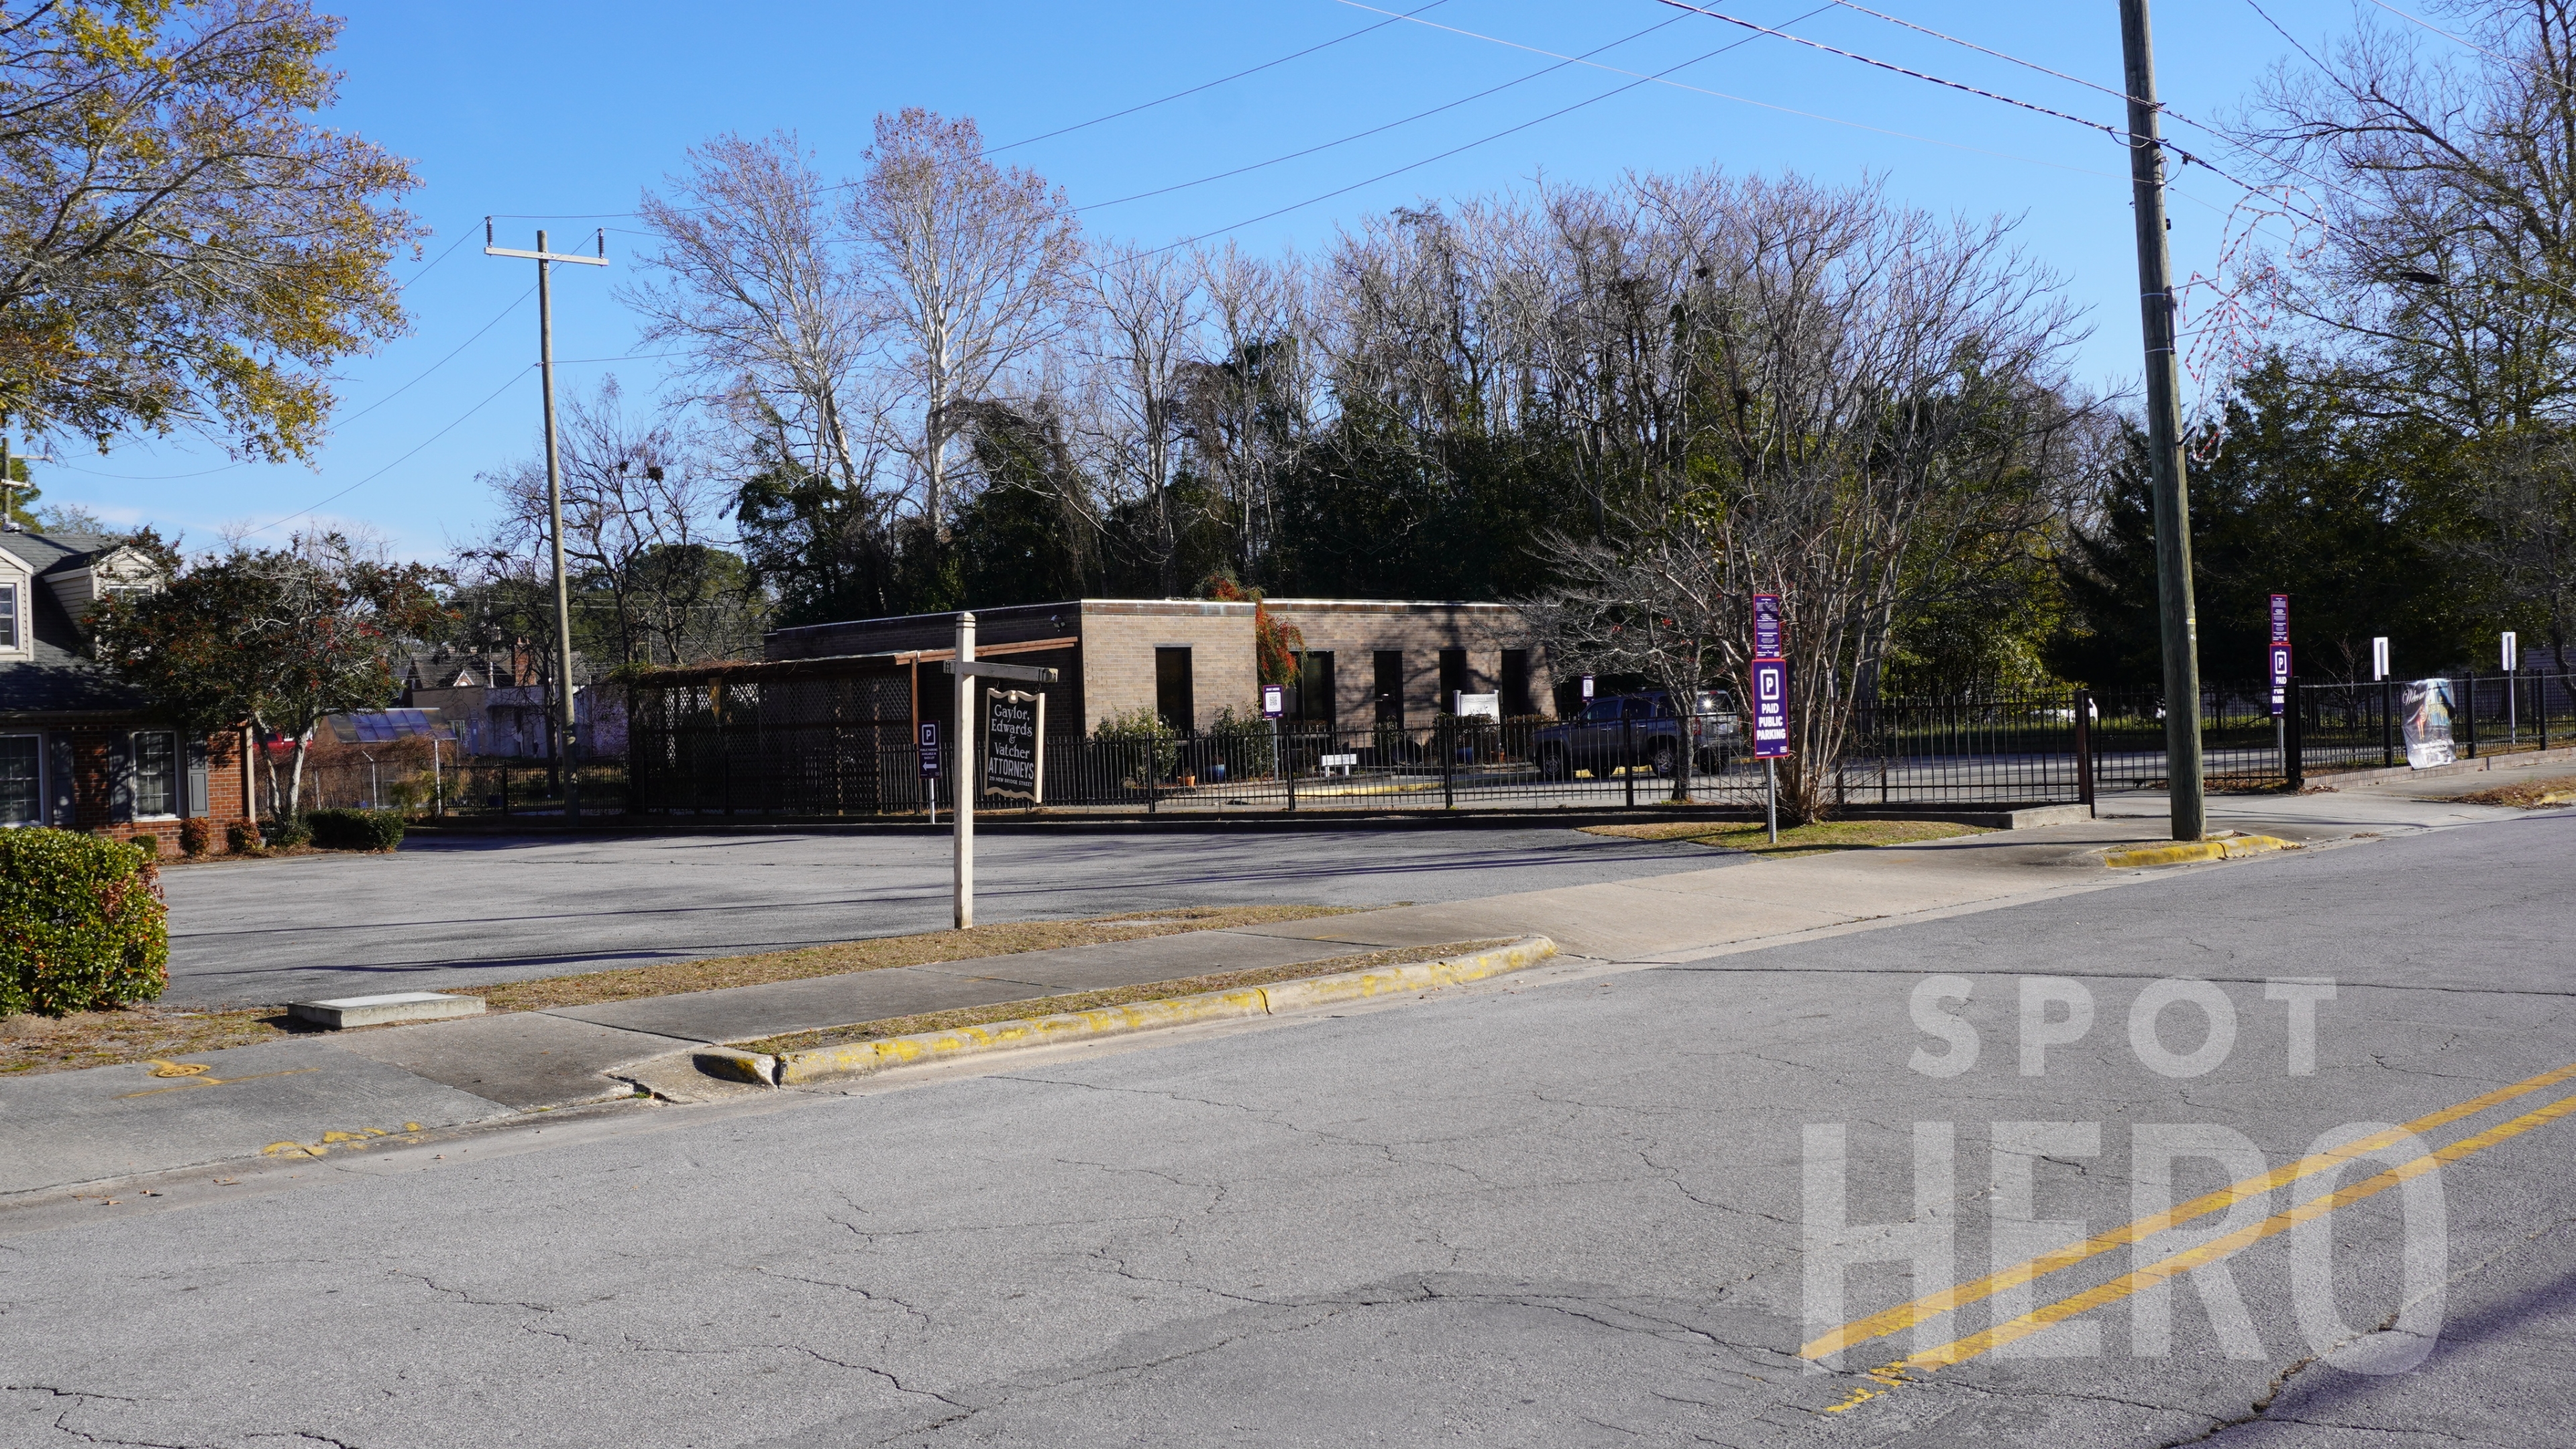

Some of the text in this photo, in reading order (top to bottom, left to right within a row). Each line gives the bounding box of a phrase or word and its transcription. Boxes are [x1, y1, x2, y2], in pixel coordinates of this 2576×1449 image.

[1766, 677, 1774, 692] P
[2275, 676, 2288, 684] PAID
[2272, 695, 2285, 704] PARK
[994, 704, 1030, 722] Gaylor,
[1762, 703, 1779, 714] PAID
[991, 718, 1033, 737] Edwards
[1758, 716, 1783, 727] PUBLIC
[1008, 733, 1016, 744] &
[1756, 729, 1786, 741] PARKING
[994, 742, 1030, 759] Vatcher
[988, 757, 1034, 780] ATTORNEYS
